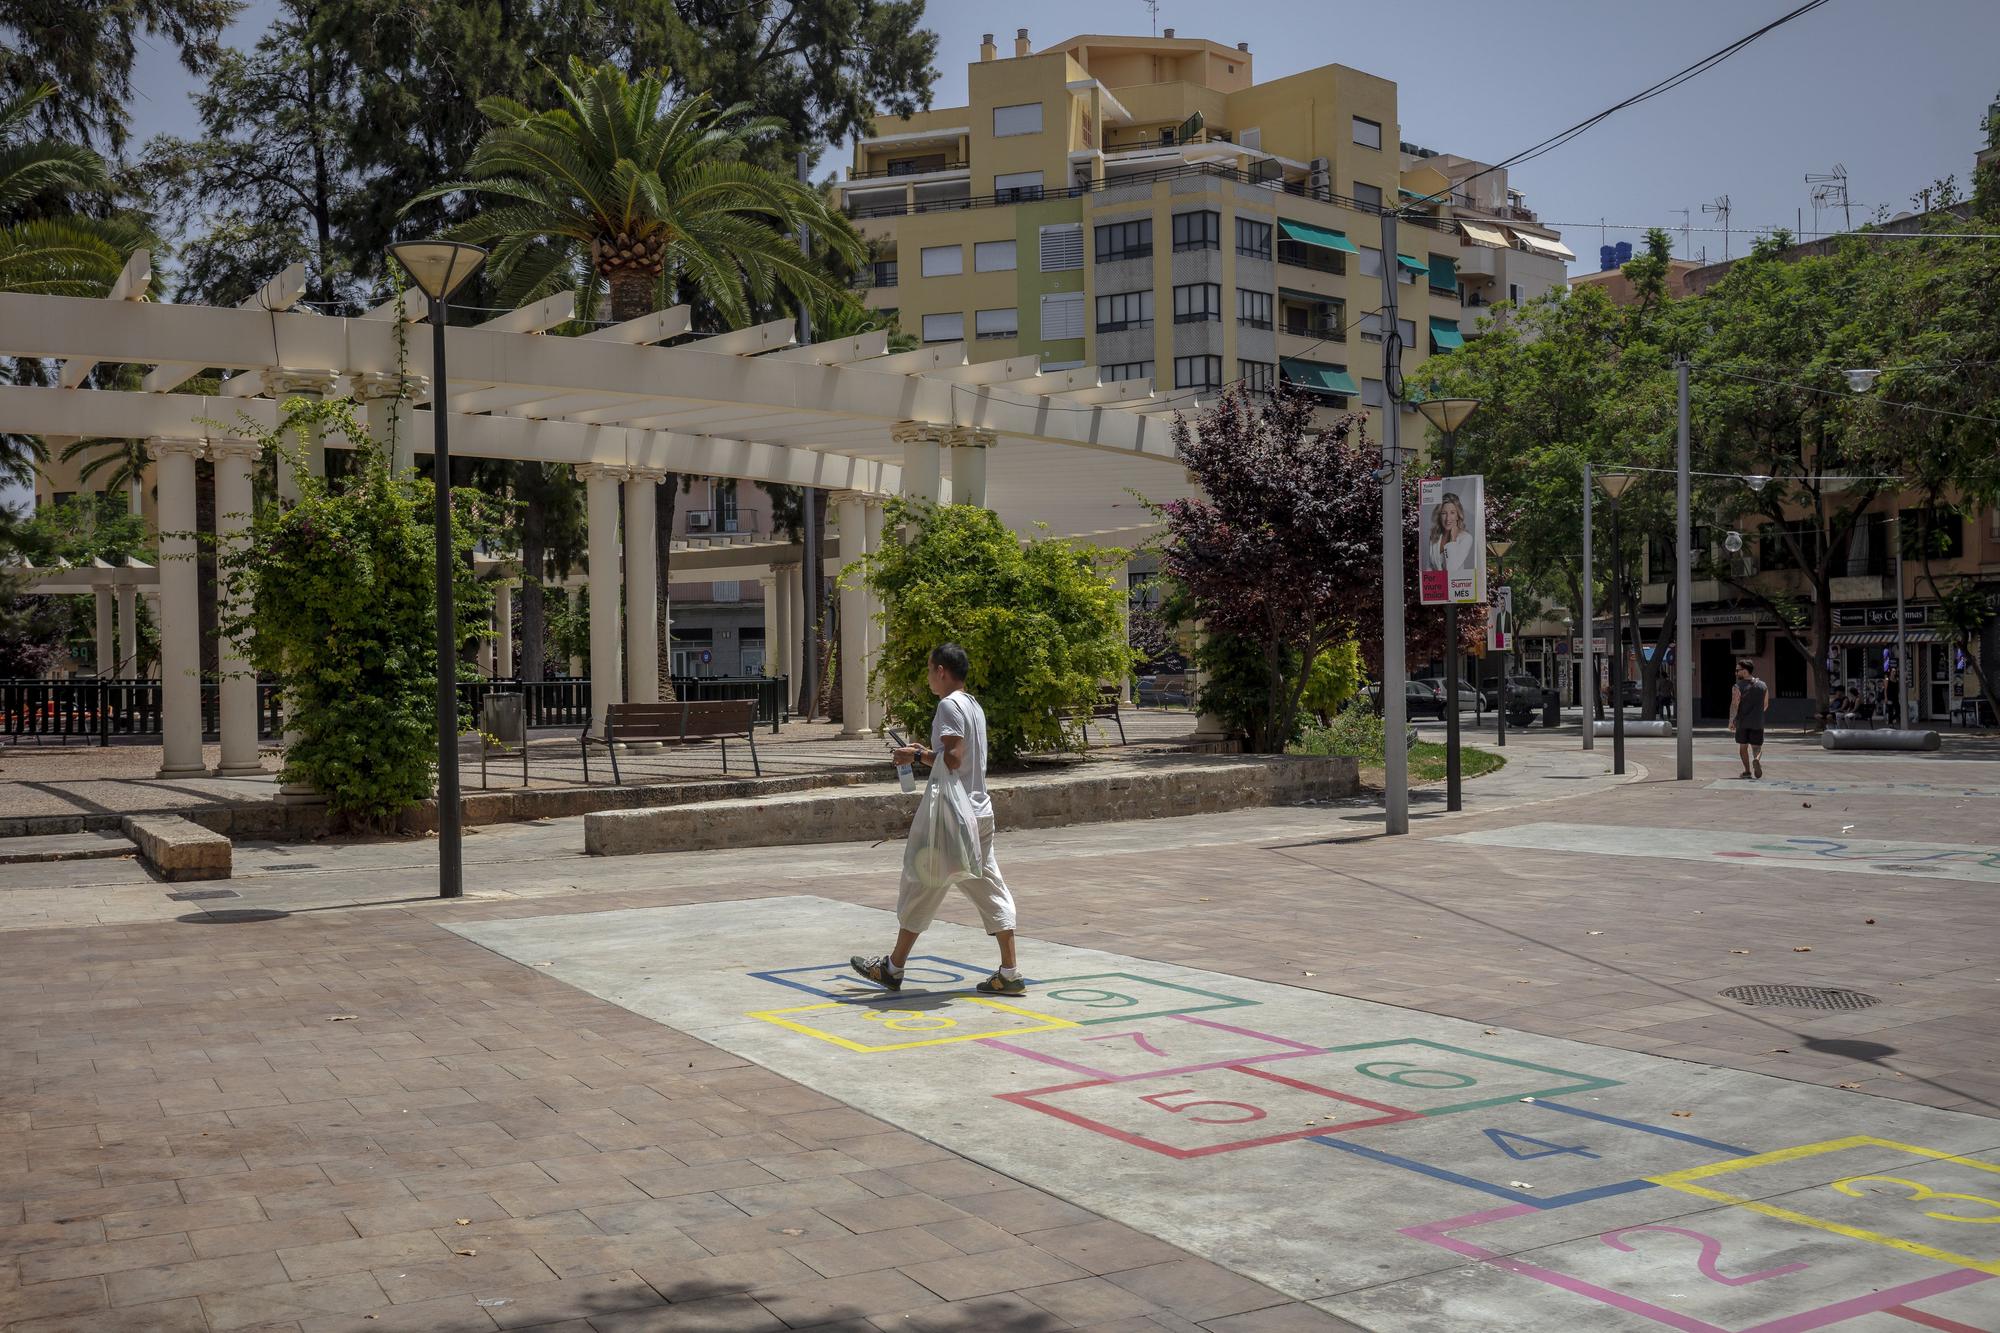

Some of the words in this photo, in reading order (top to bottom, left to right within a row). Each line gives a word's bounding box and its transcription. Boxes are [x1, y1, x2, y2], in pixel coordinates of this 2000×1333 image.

[1455, 589, 1469, 598] MÉS
[1884, 610, 1922, 621] Colmnas
[1047, 989, 1139, 1008] 9
[862, 1009, 957, 1031] 8
[1080, 1031, 1169, 1057] 7
[1355, 1061, 1477, 1089] 6
[1138, 1089, 1268, 1124] 5
[1482, 1128, 1602, 1160] 4
[1831, 1176, 2000, 1223] 3
[1600, 1225, 1811, 1286] 2
